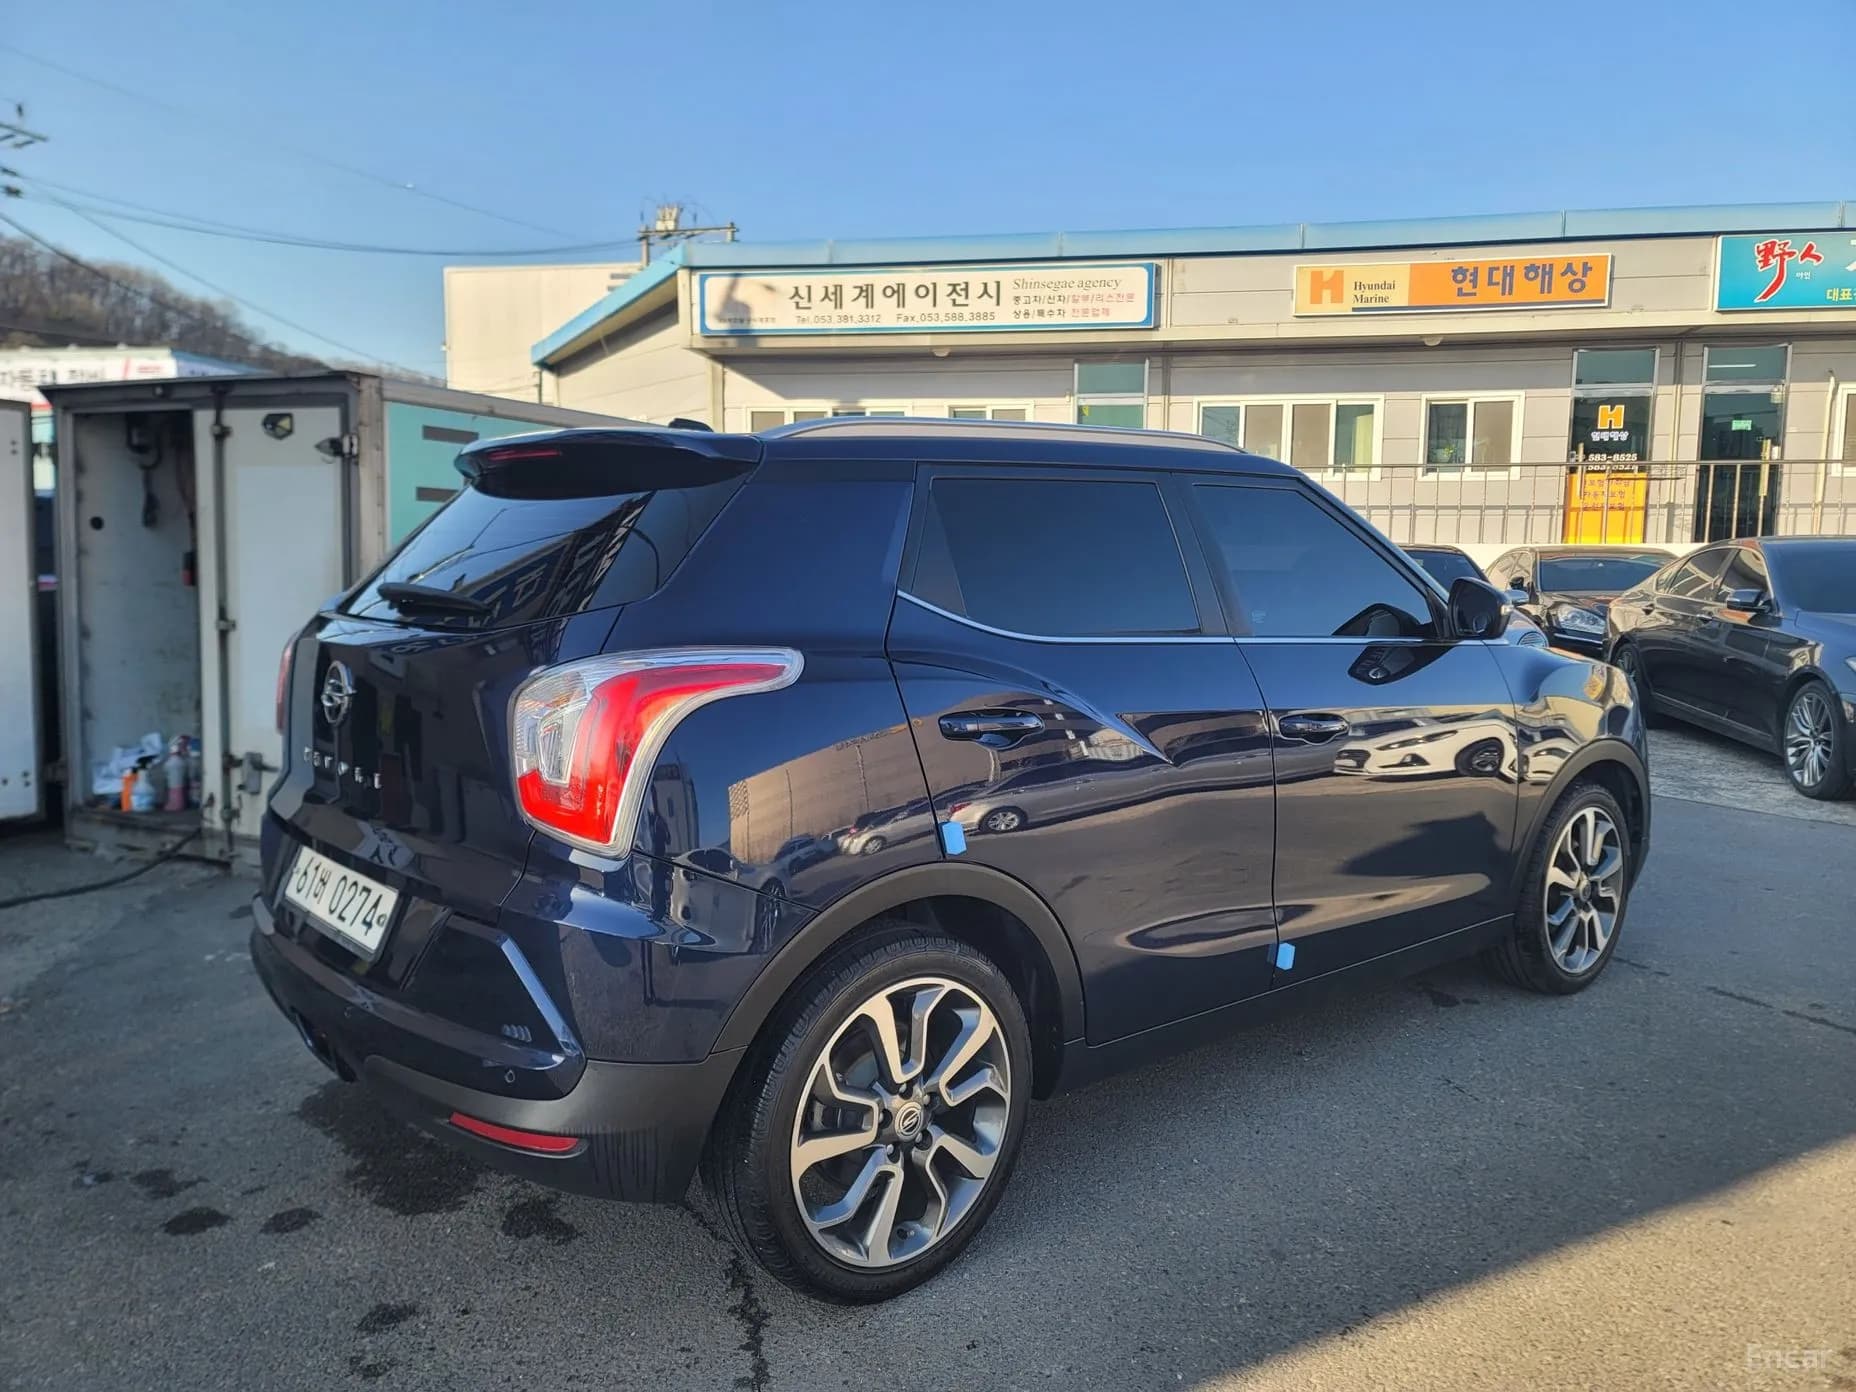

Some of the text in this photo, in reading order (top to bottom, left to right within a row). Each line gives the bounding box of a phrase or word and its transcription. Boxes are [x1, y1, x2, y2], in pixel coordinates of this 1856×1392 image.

[1451, 262, 1592, 297] 현대해상
[1754, 239, 1823, 302] 野人
[1013, 278, 1122, 291] Shinsegae agency
[1353, 280, 1396, 293] Hyundai
[1826, 288, 1856, 302] 대표
[789, 281, 1001, 310] 신세계에이전시
[1353, 293, 1390, 304] Marine
[328, 875, 383, 936] 0274
